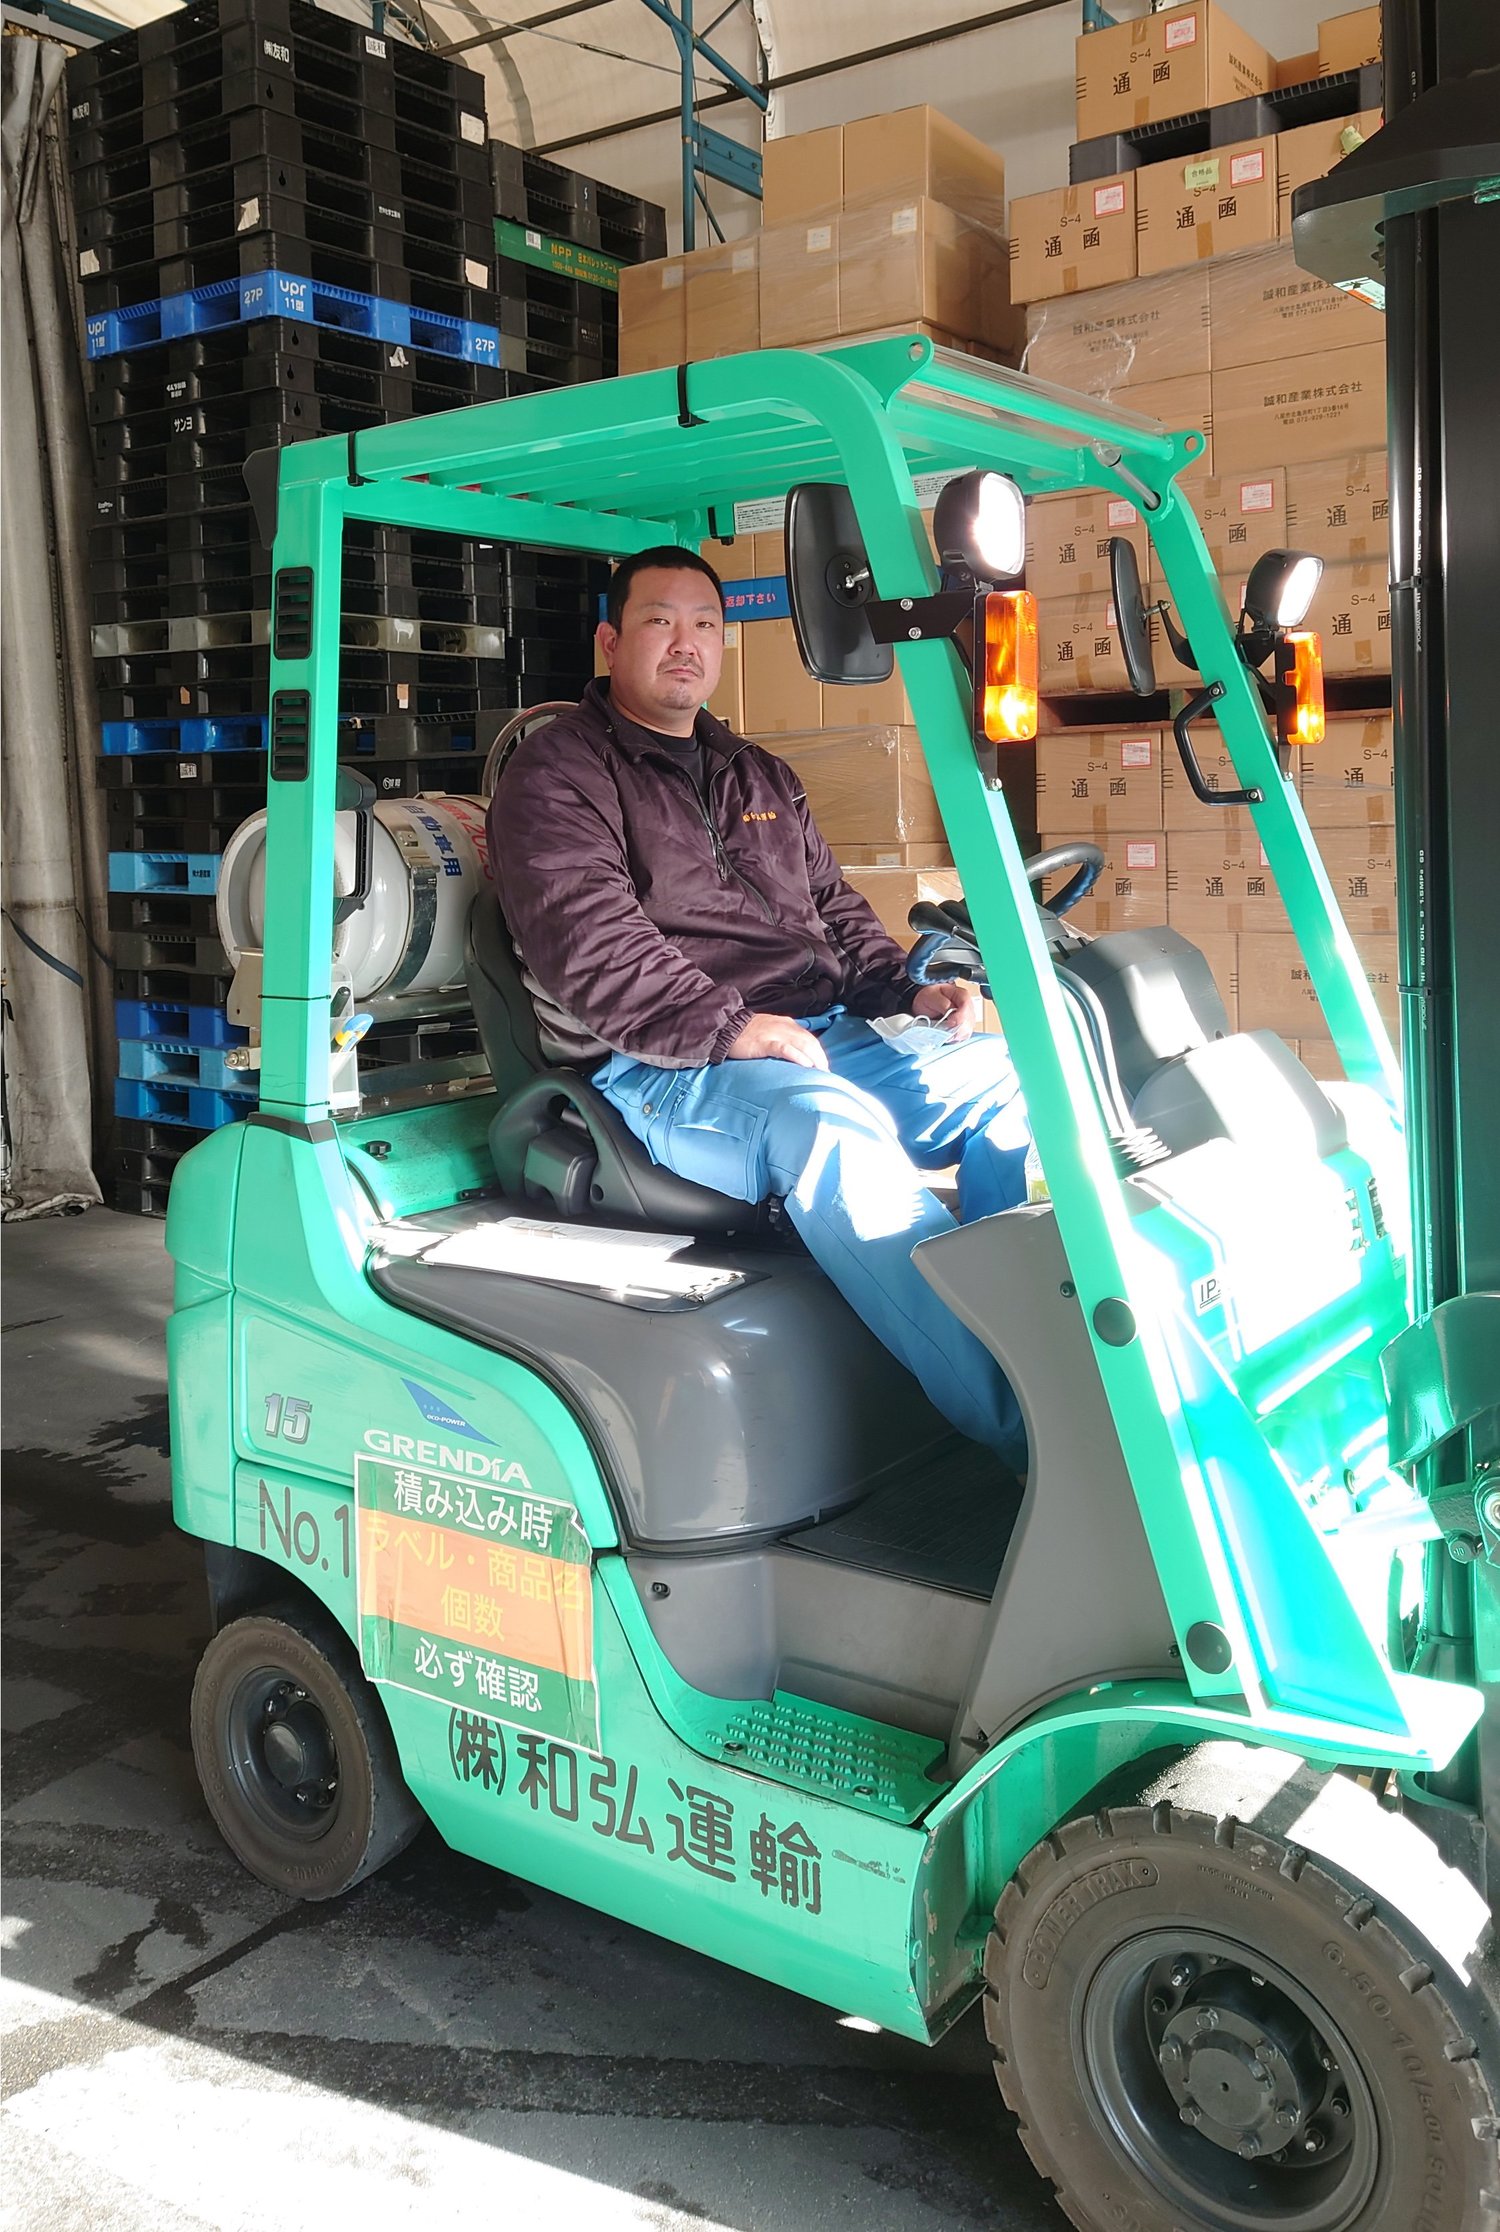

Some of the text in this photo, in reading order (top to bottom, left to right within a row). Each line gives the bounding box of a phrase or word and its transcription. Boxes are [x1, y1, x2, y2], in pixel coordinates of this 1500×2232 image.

[1130, 48, 1151, 63] S-4
[1193, 183, 1217, 198] S-4
[1060, 213, 1082, 229] S-4
[551, 243, 572, 257] NPP
[280, 279, 307, 297] upr
[244, 288, 263, 304] 27P
[88, 320, 107, 334] upr
[475, 337, 496, 352] 27P
[1263, 380, 1363, 407] 誠和産業株式会社
[173, 415, 193, 433] サンヨ
[1345, 483, 1371, 497] S-4
[1203, 507, 1227, 521] S-4
[1074, 524, 1095, 536] S-4
[1350, 593, 1376, 606] S-4
[1072, 621, 1094, 634] S-4
[1363, 749, 1388, 760] S-4
[1087, 761, 1109, 772] S-4
[402, 805, 463, 877] 自動車用
[1222, 859, 1246, 871] S-4
[1366, 859, 1392, 870] S-4
[264, 1392, 313, 1445] 15
[393, 1469, 554, 1549] 積み込み時
[258, 1478, 350, 1579] No.1
[365, 1516, 586, 1612] ラベル・商品名
[441, 1583, 506, 1642] 個数
[413, 1636, 543, 1712] 必ず確認
